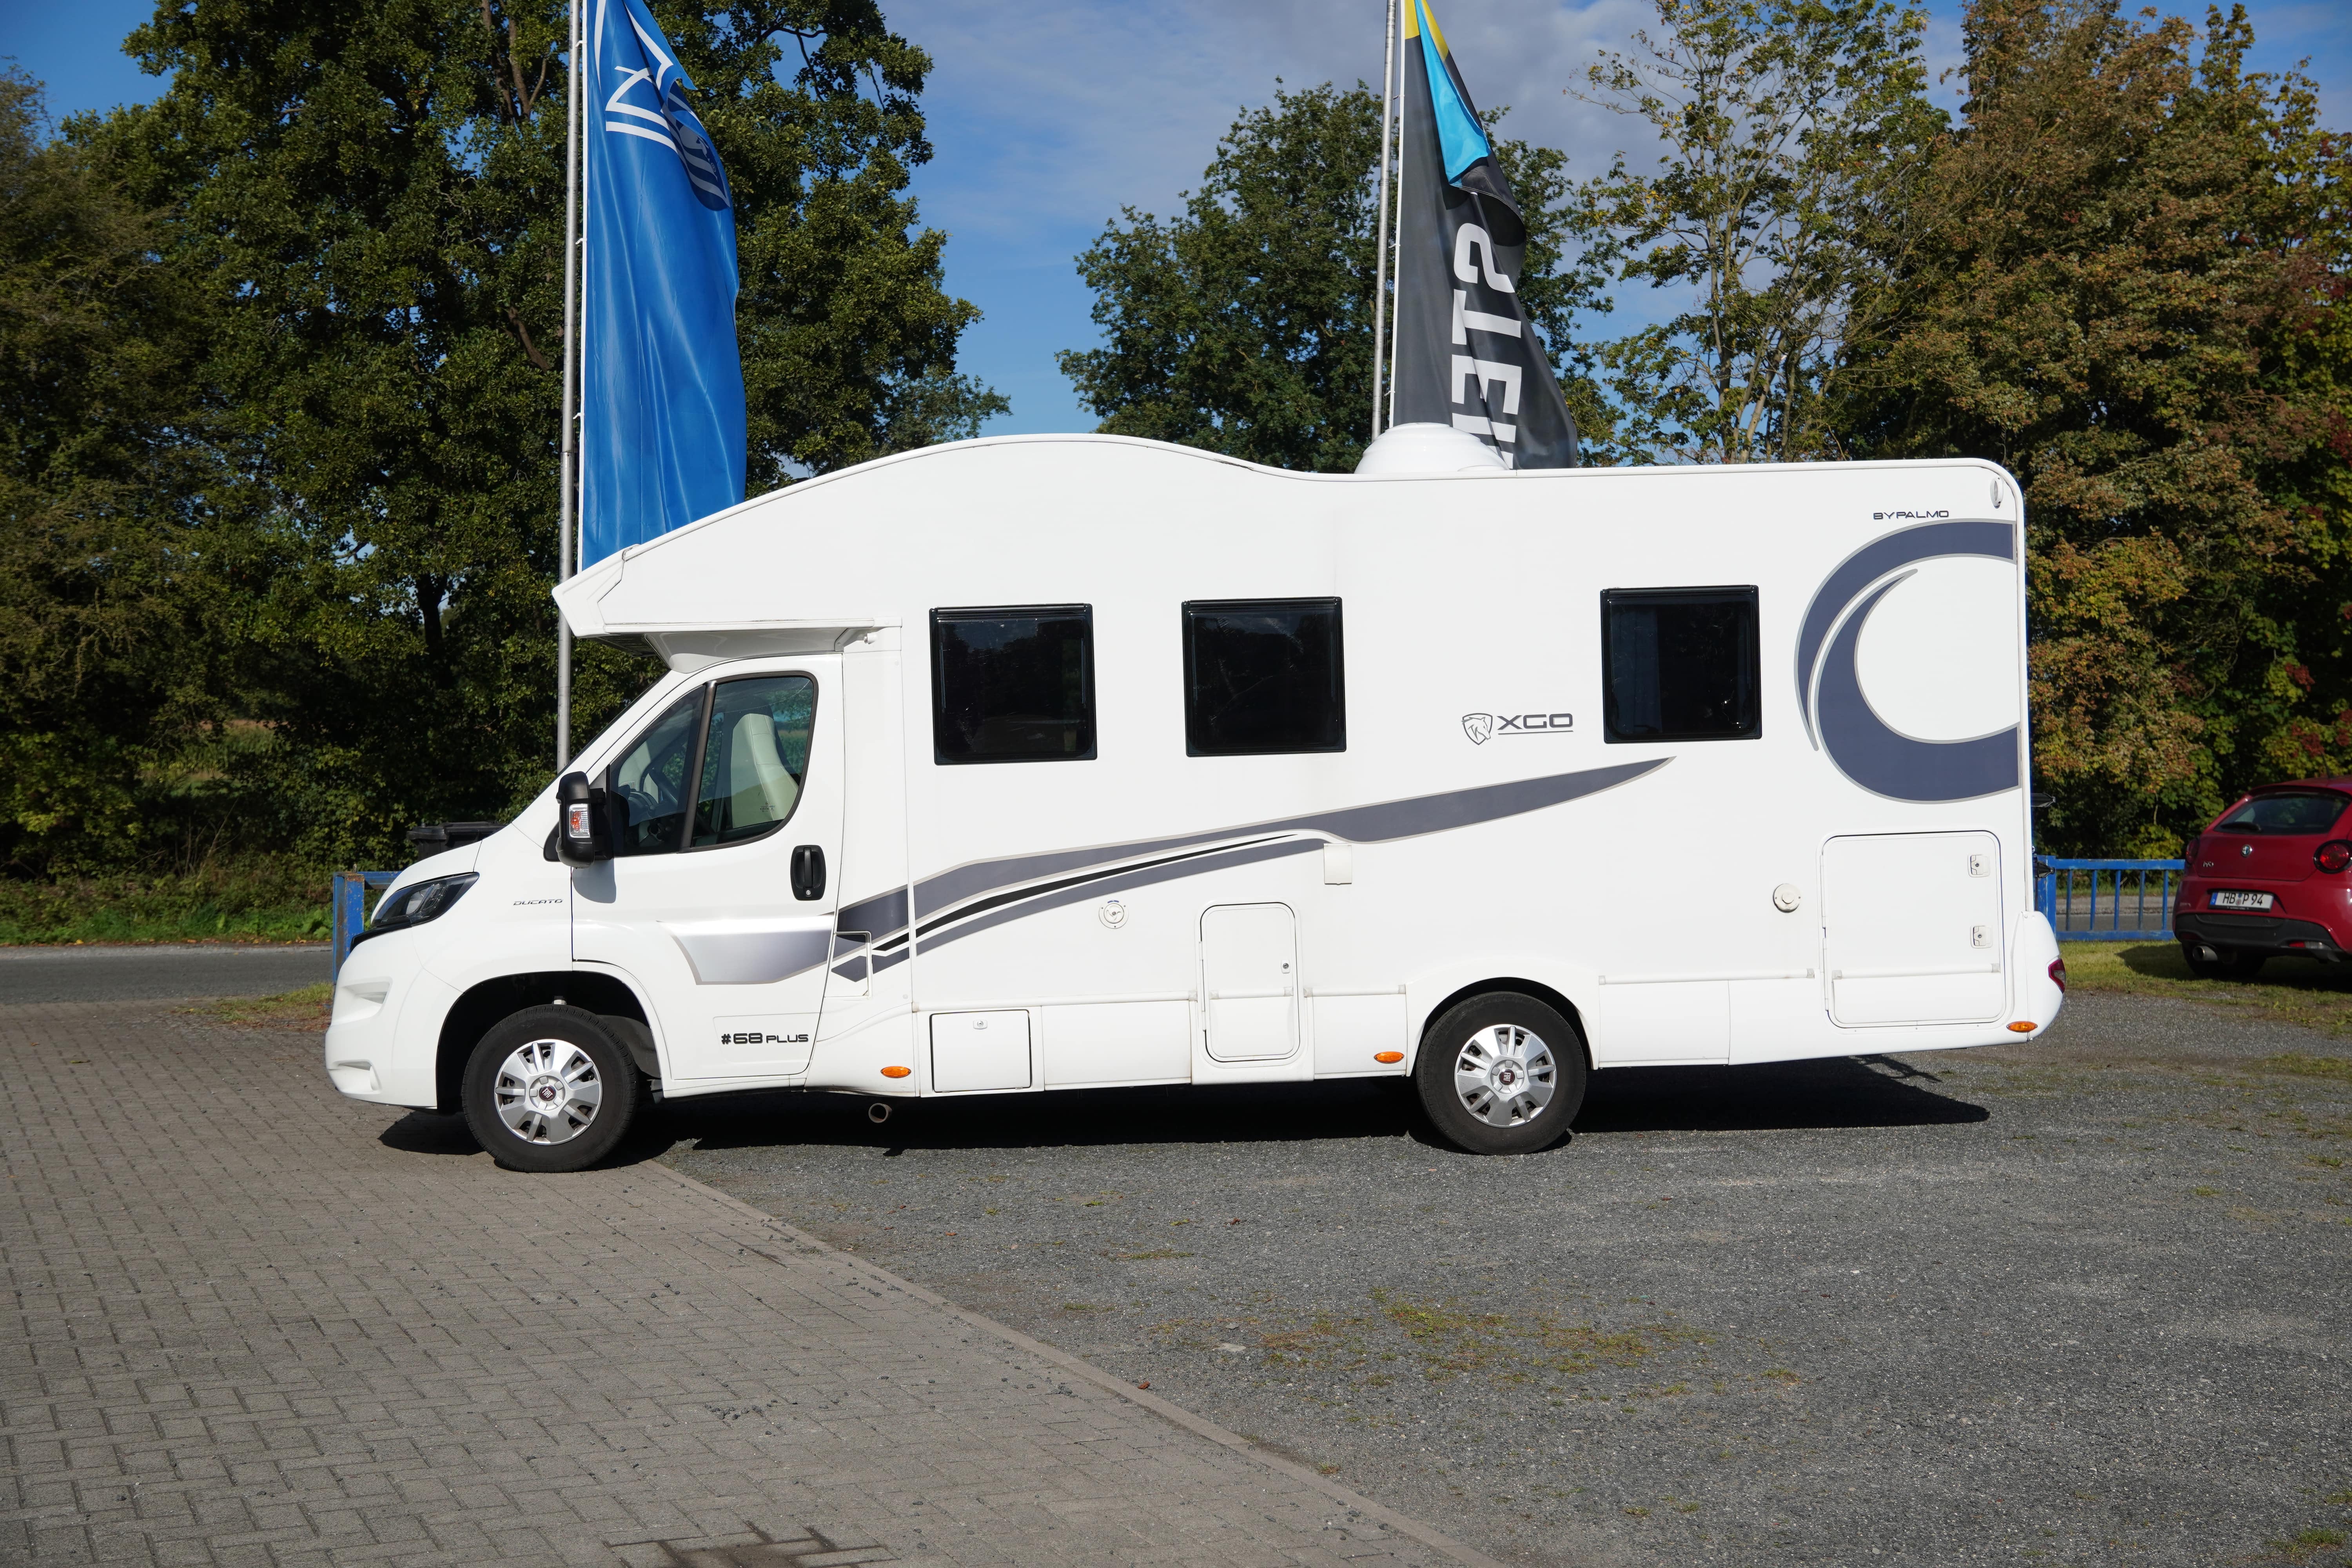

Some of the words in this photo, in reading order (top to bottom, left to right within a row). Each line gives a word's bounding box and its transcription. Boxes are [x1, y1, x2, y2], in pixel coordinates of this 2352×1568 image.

[1497, 713, 1573, 730] XGO
[2223, 893, 2236, 904] HB
[721, 1033, 763, 1045] #68
[766, 1034, 809, 1044] PLUS
[1503, 1072, 1511, 1082] FIAT
[542, 1088, 553, 1098] FIAT
